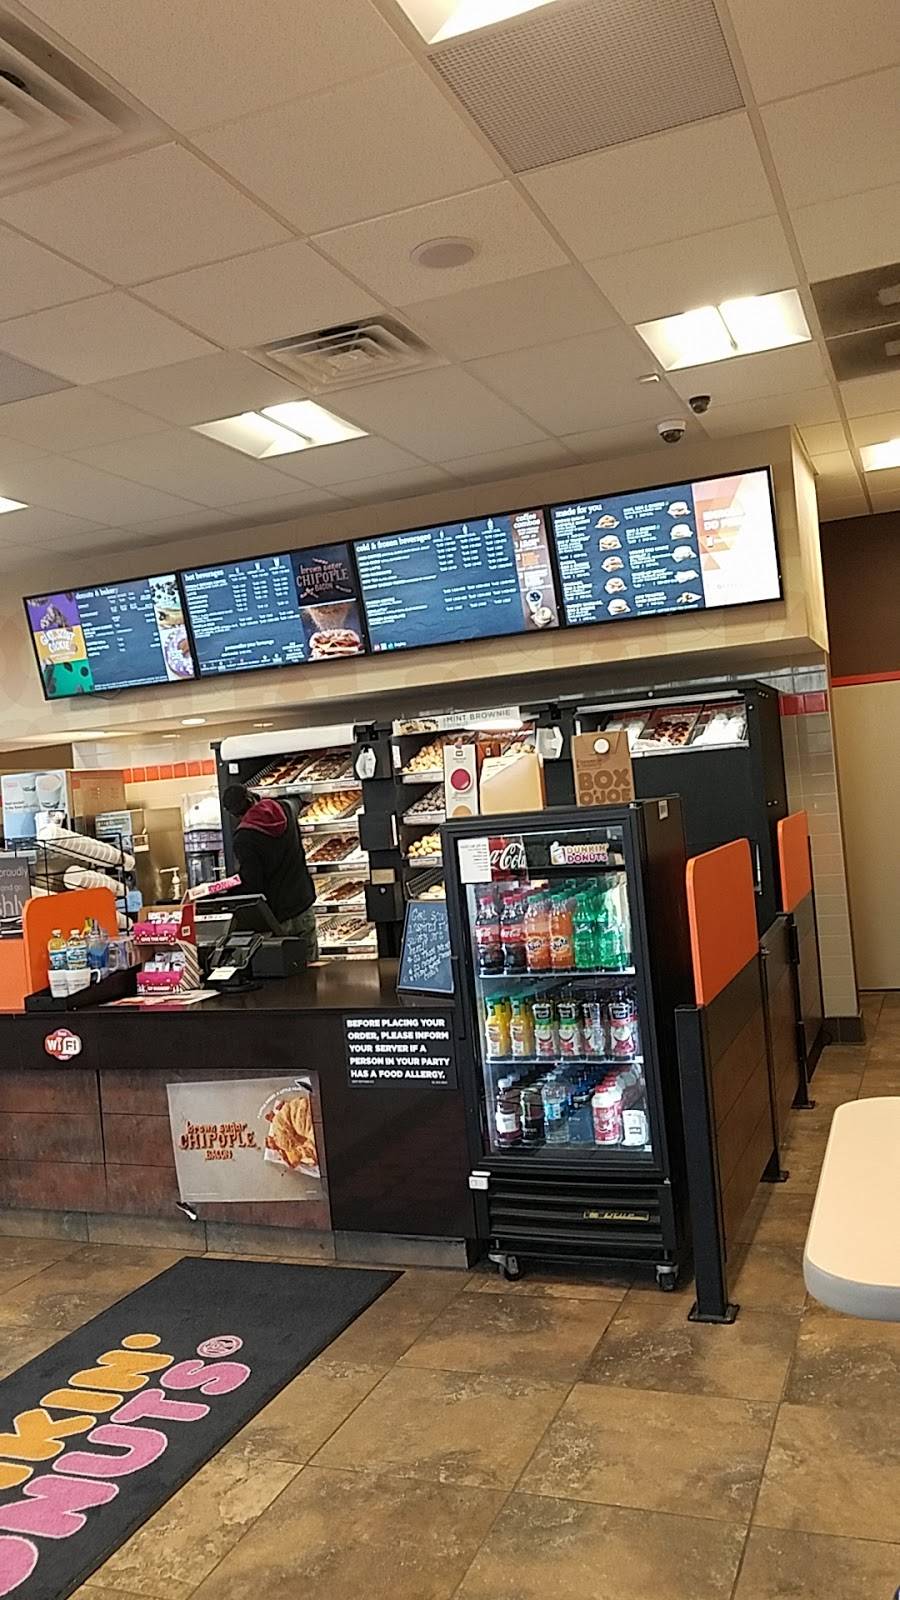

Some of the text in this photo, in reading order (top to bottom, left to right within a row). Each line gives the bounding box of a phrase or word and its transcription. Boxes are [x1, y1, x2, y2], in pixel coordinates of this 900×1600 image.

[296, 568, 349, 587] CHIPOTLE
[446, 709, 512, 724] MINT BROWNIE
[578, 769, 631, 790] BOX
[567, 852, 608, 864] DONUTS
[346, 1018, 446, 1028] BEFORE PLACING YOUR
[347, 1031, 450, 1041] ORDER, PLEASE INFORM
[348, 1044, 427, 1053] YOUR SERVER IF A
[349, 1056, 450, 1066] PERSON IN YOUR PARTY
[350, 1069, 446, 1079] HAS A FOOD ALLERGY.
[187, 1120, 217, 1134] brown
[180, 1131, 257, 1150] CHIPOTLE
